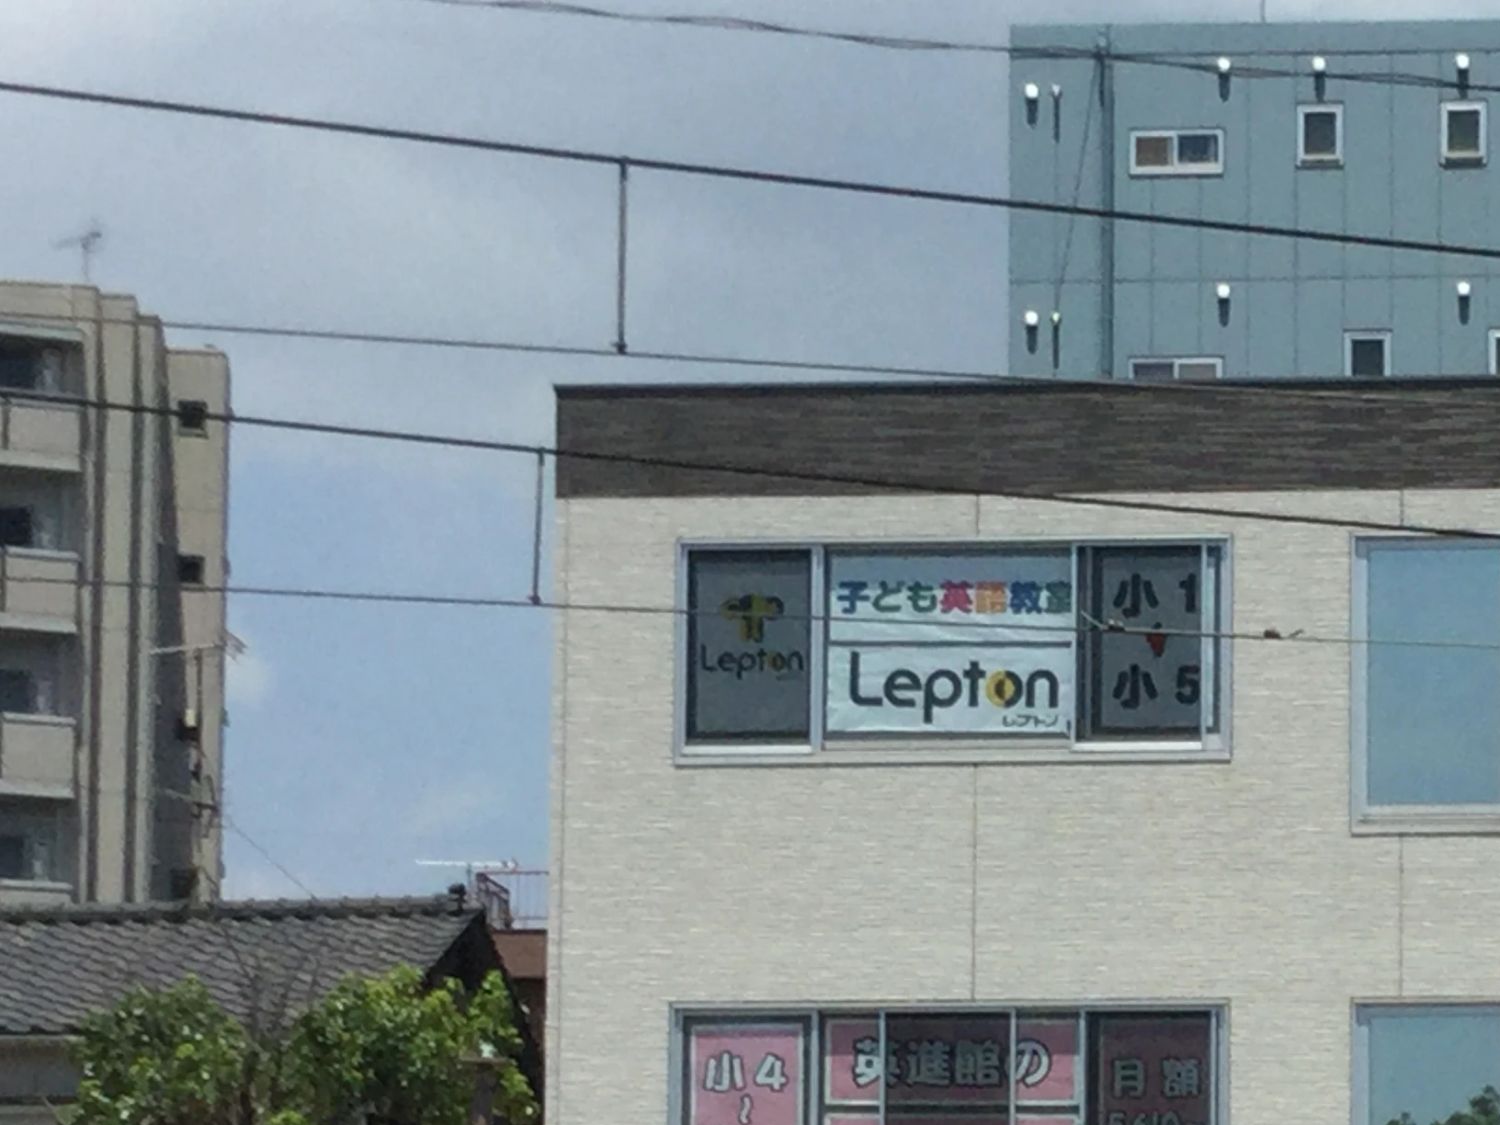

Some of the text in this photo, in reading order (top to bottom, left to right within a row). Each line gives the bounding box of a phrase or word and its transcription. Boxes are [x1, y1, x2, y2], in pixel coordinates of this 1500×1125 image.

[836, 580, 1072, 614] 子ども英語教室
[700, 644, 804, 680] Lepton
[849, 651, 1059, 724] Lepton
[1002, 713, 1060, 728] レプトン
[702, 1049, 787, 1093] 小4
[852, 1039, 1051, 1088] 英進館の
[1112, 1058, 1201, 1098] 月額
